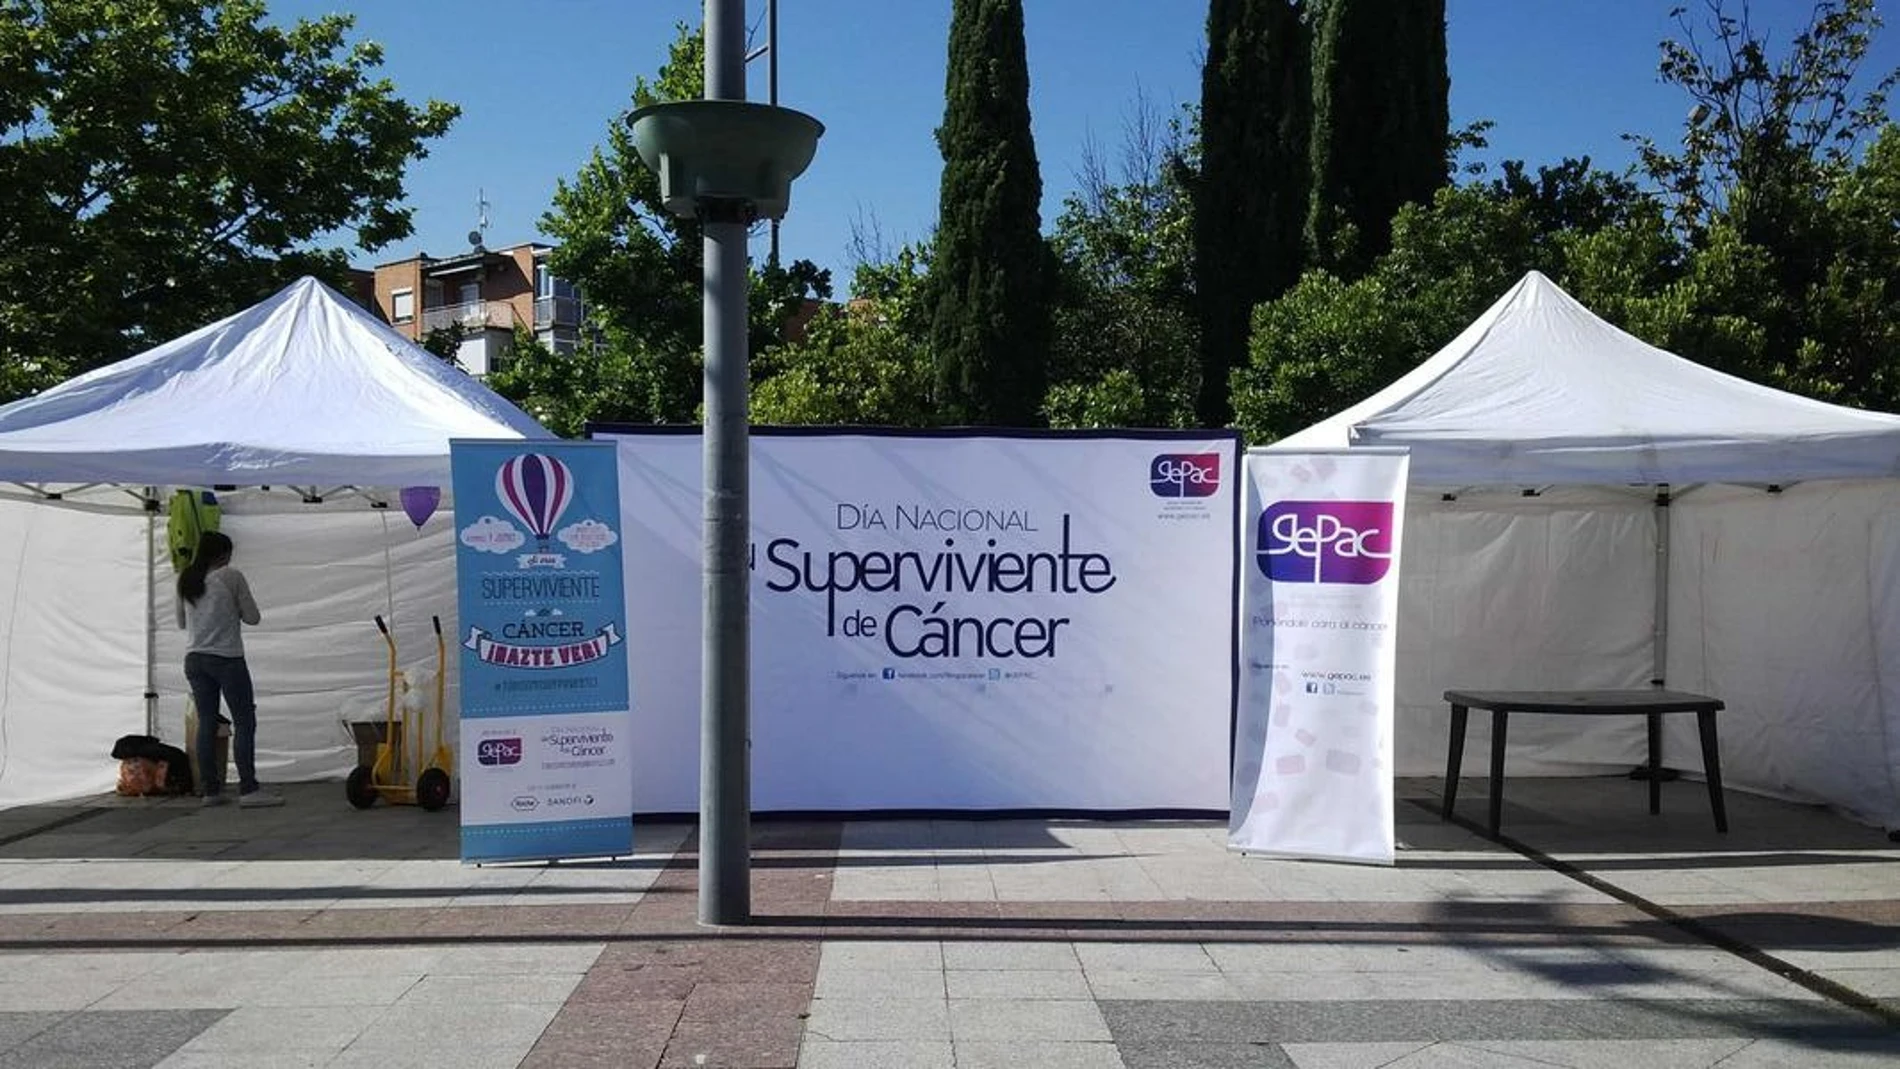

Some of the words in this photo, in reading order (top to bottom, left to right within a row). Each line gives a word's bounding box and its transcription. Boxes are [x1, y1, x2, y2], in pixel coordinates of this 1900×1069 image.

[895, 503, 1039, 532] NACIONAL
[481, 576, 600, 600] SUPERVIVIENTE
[765, 513, 1117, 637] Superviviente
[502, 618, 585, 639] CÁNCER
[842, 610, 877, 638] de
[884, 601, 1070, 659] Cáncer
